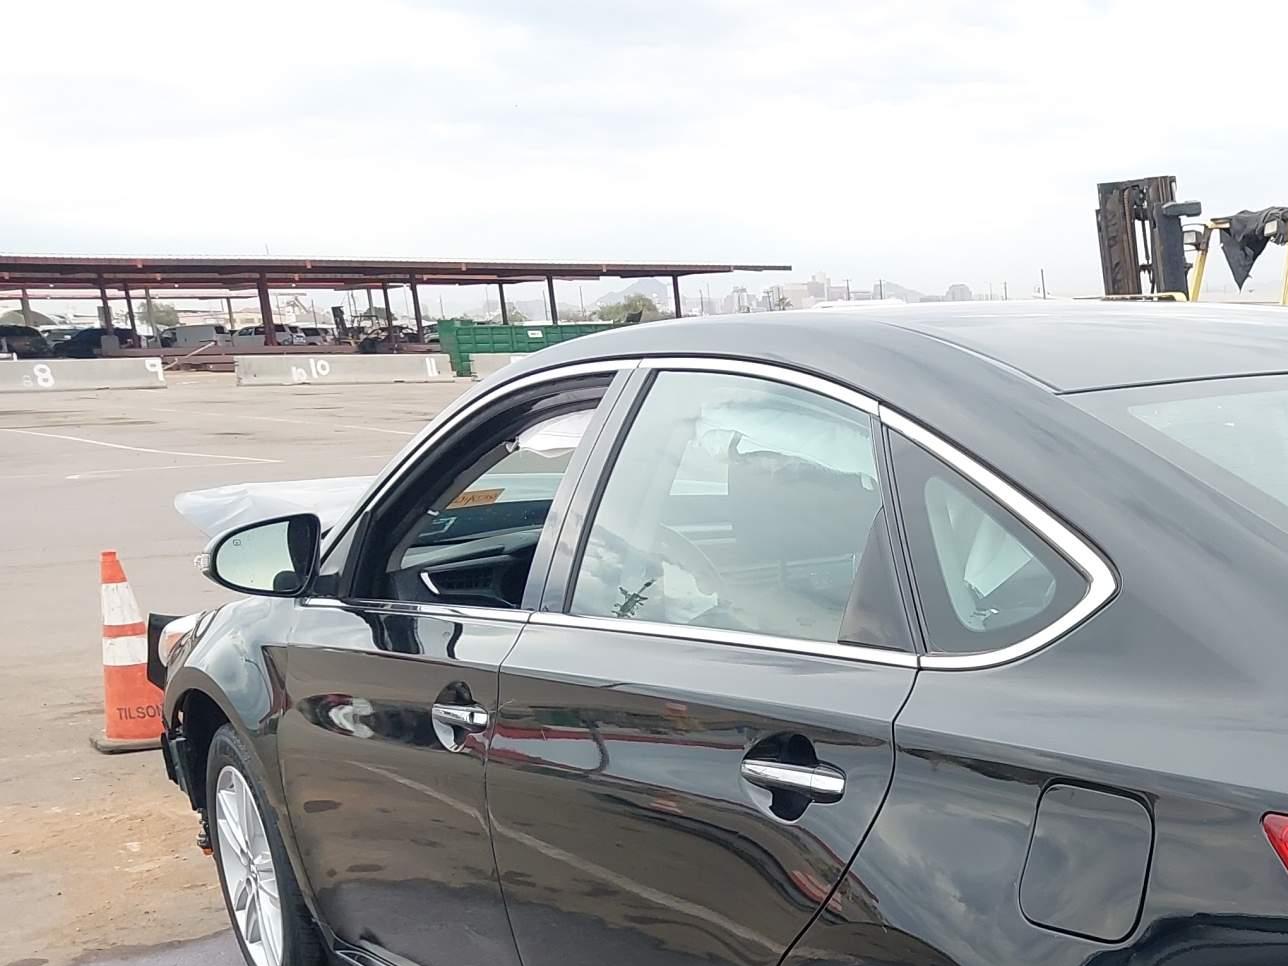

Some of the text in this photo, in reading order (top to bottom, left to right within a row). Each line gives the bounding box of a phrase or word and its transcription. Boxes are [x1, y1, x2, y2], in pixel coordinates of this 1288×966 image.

[33, 363, 55, 388] 8
[144, 359, 166, 383] 9
[308, 358, 330, 379] 10
[425, 357, 440, 377] 11
